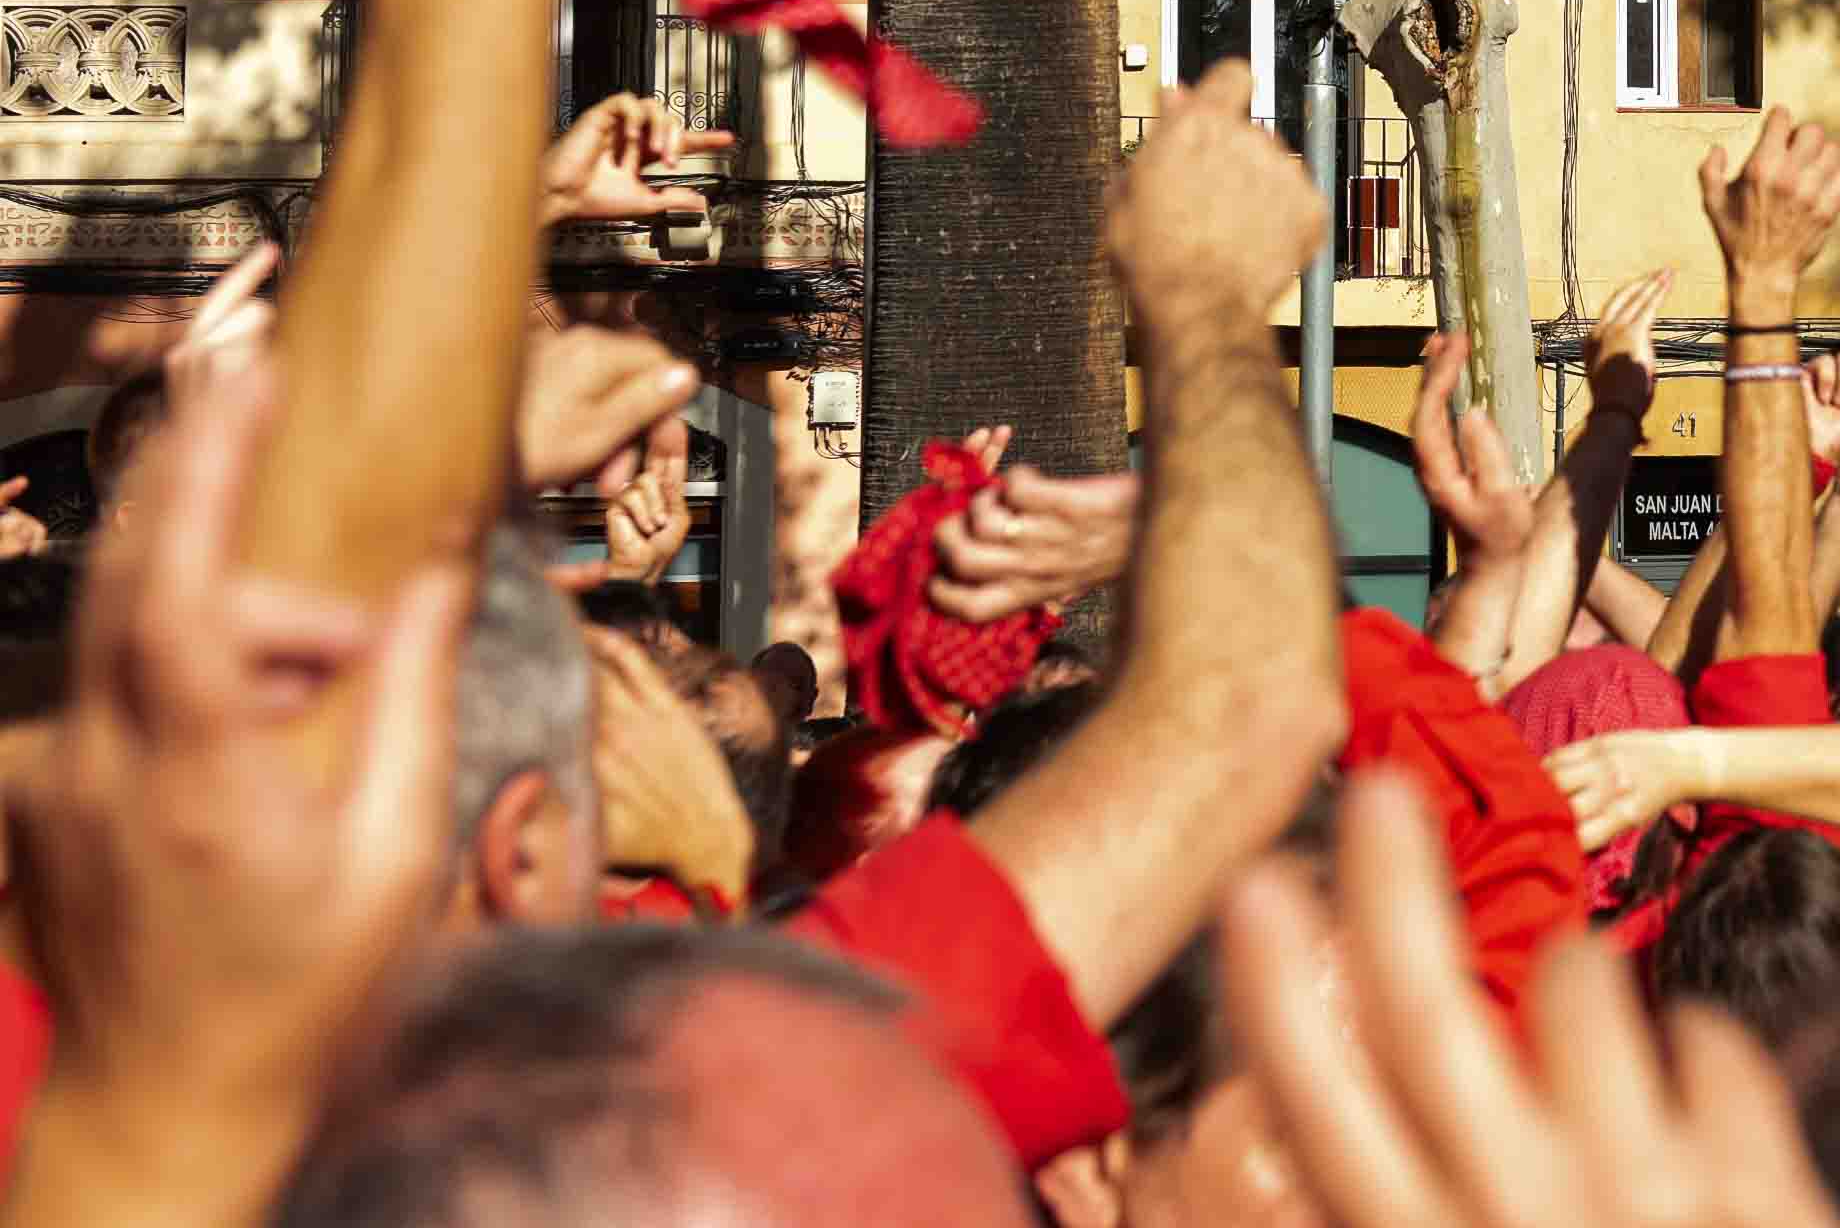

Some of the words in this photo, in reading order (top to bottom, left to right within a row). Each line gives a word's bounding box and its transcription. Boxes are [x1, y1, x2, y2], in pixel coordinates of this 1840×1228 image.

[1671, 412, 1696, 437] 41
[1634, 494, 1667, 515] SAN
[1670, 494, 1711, 515] JUAN
[1649, 521, 1699, 541] MALTA
